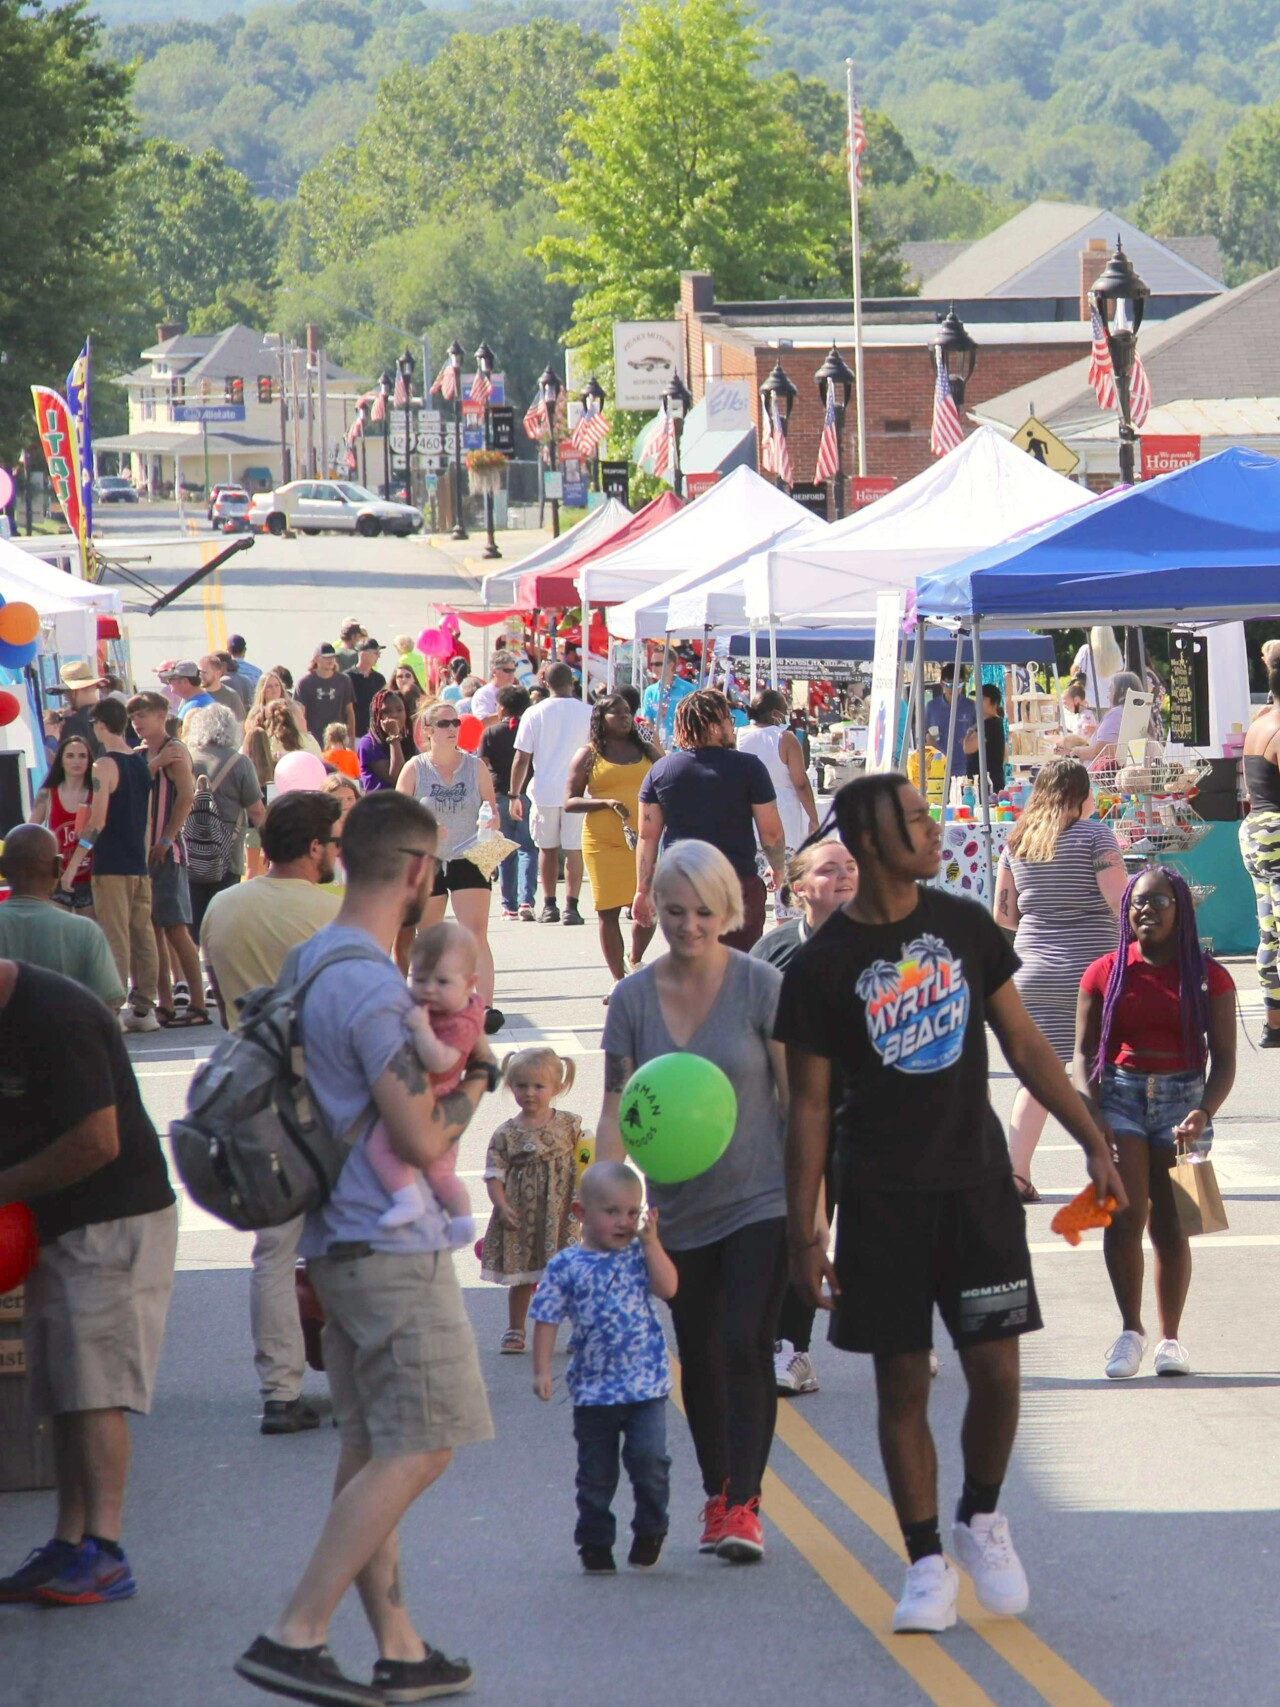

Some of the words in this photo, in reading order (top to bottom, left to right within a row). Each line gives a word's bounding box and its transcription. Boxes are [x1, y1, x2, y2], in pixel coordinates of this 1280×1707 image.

[419, 434, 440, 450] 460
[793, 492, 825, 501] BEDFORD
[855, 490, 882, 500] Hon
[866, 958, 962, 1039] MYRTLE
[882, 996, 964, 1066] BEACH
[0, 1296, 25, 1310] er
